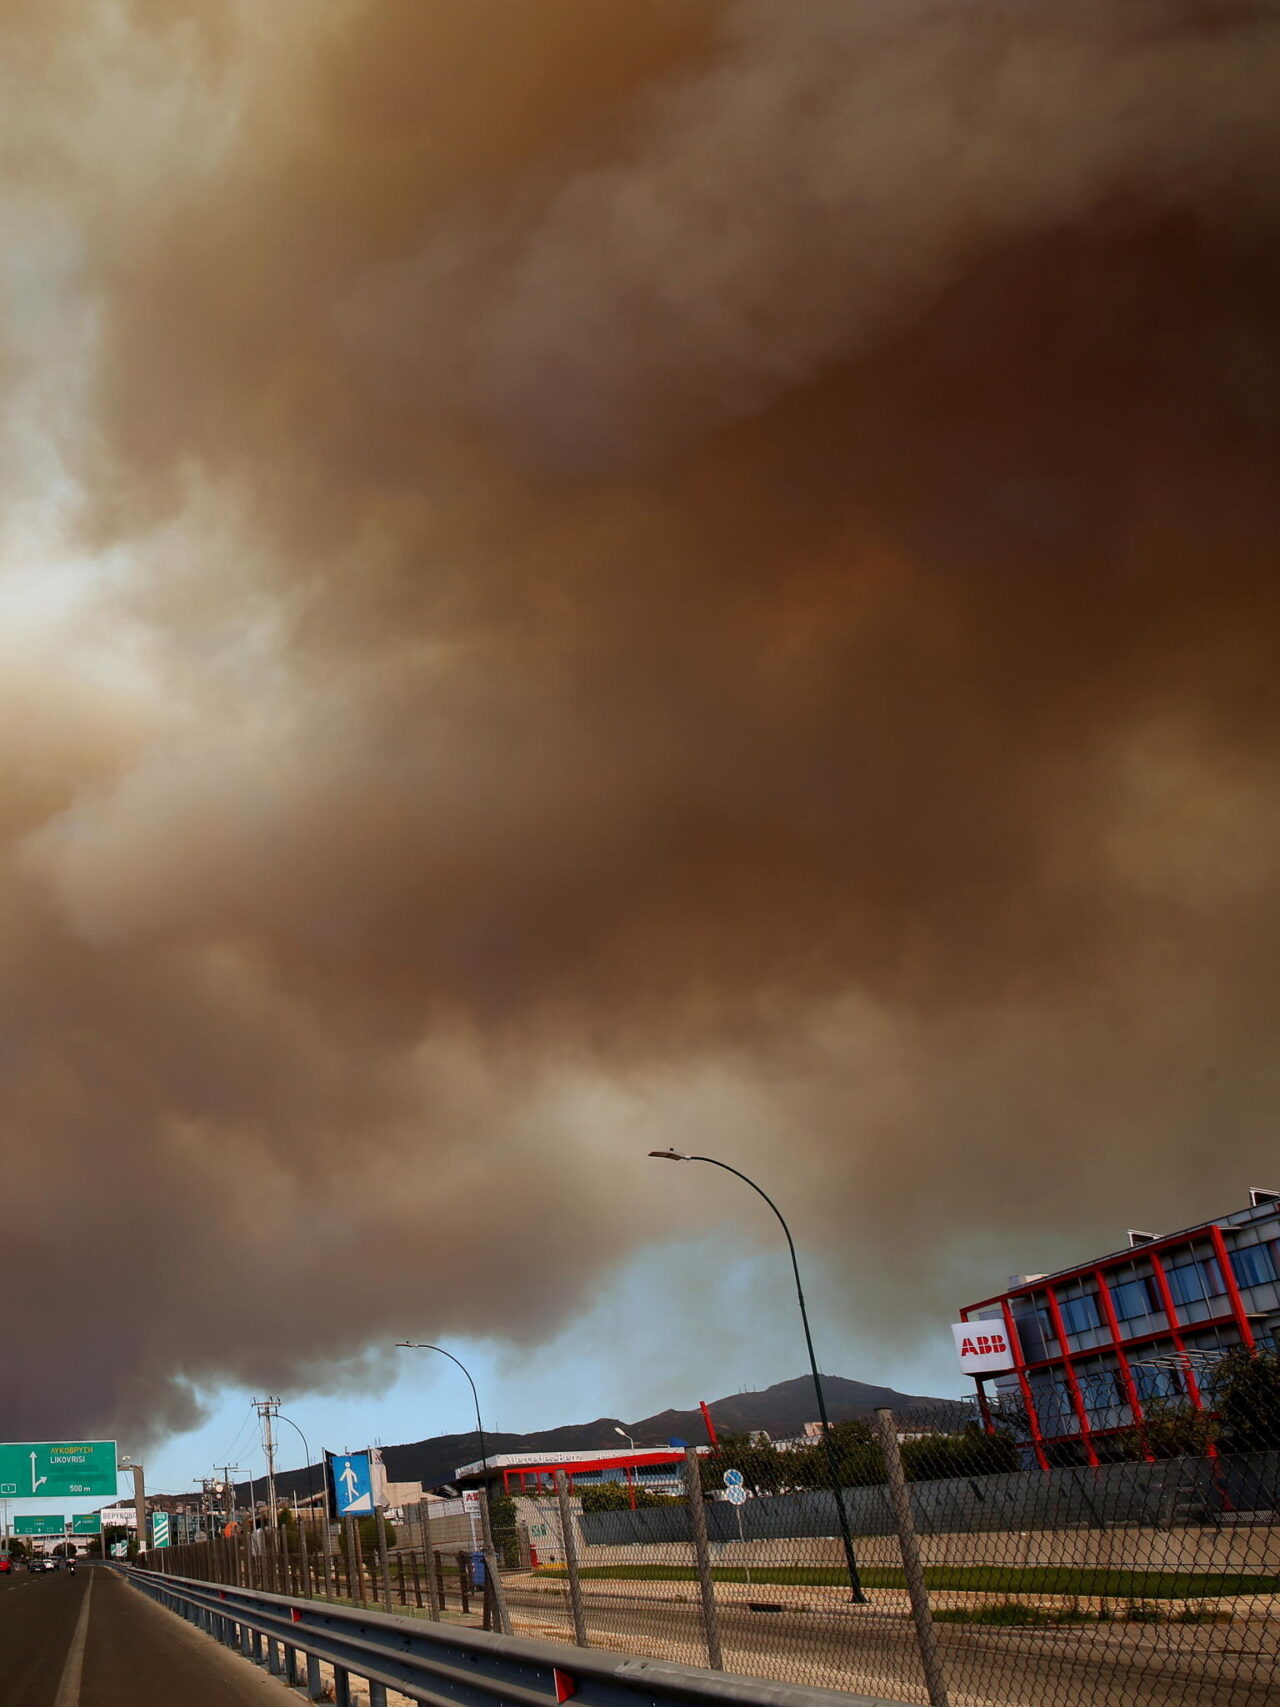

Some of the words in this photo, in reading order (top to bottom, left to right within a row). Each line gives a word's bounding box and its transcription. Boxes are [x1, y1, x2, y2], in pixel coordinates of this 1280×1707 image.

[961, 1335, 1006, 1356] ABB
[50, 1446, 94, 1455] ΛΥΚΟΒΡΥΣΗ
[50, 1455, 86, 1464] LIKOVRISI
[69, 1484, 82, 1492] 500
